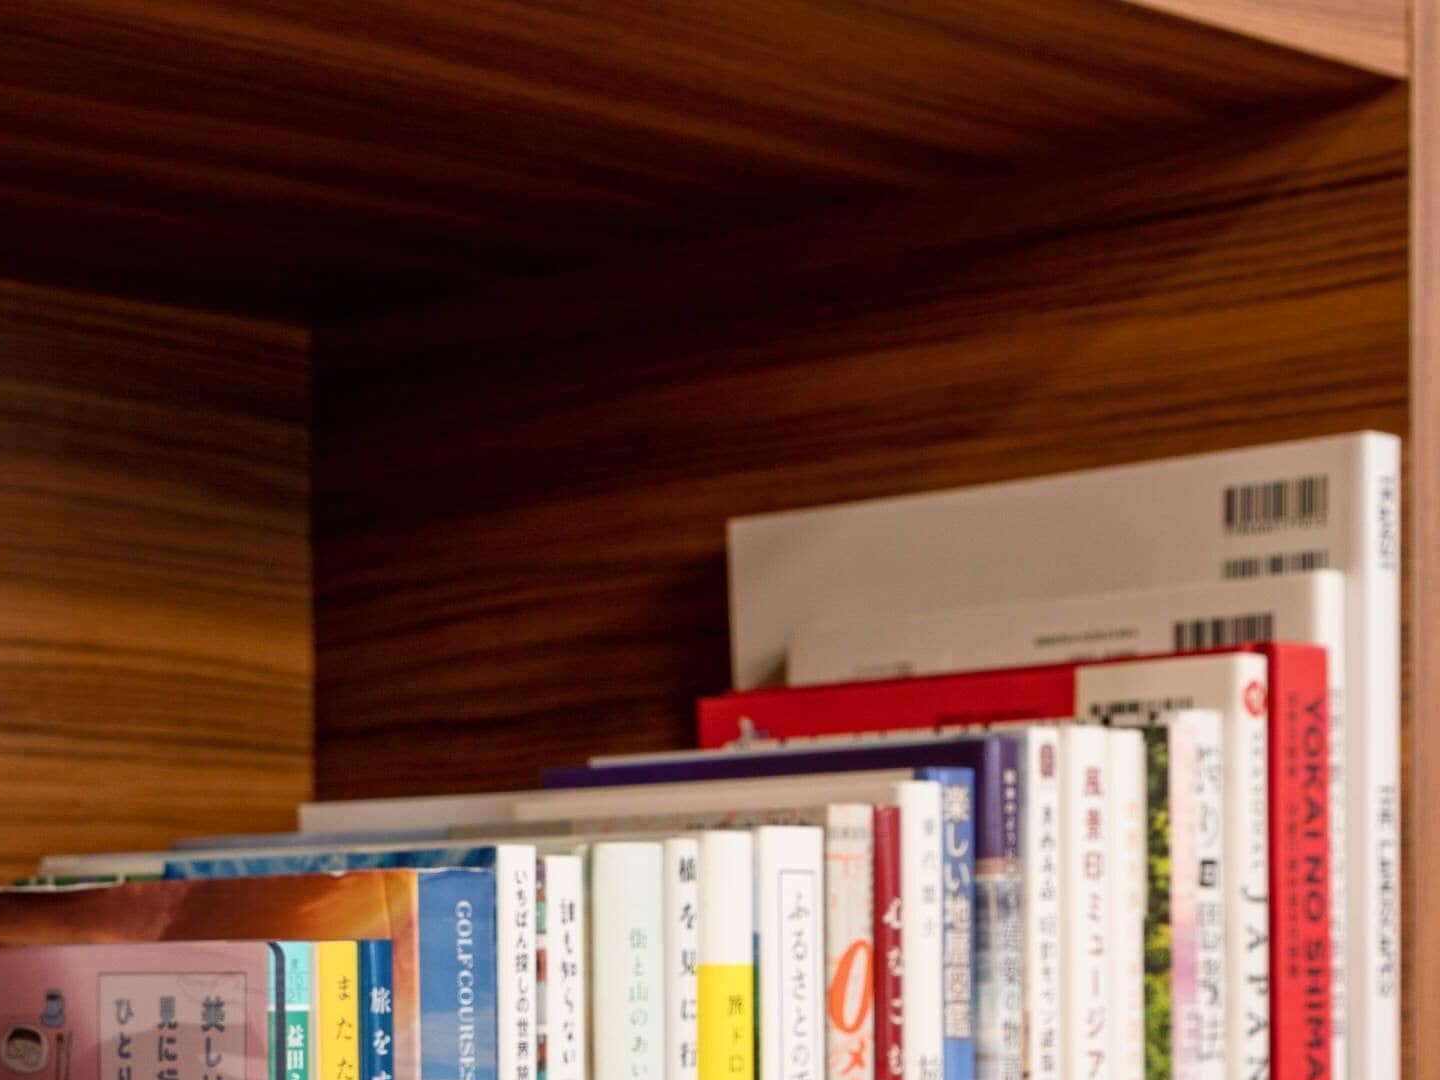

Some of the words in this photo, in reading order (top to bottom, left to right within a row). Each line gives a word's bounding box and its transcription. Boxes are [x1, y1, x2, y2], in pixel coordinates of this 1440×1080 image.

[1304, 699, 1324, 839] YOKAI
[1304, 856, 1325, 923] NO
[455, 899, 474, 968] GOLF
